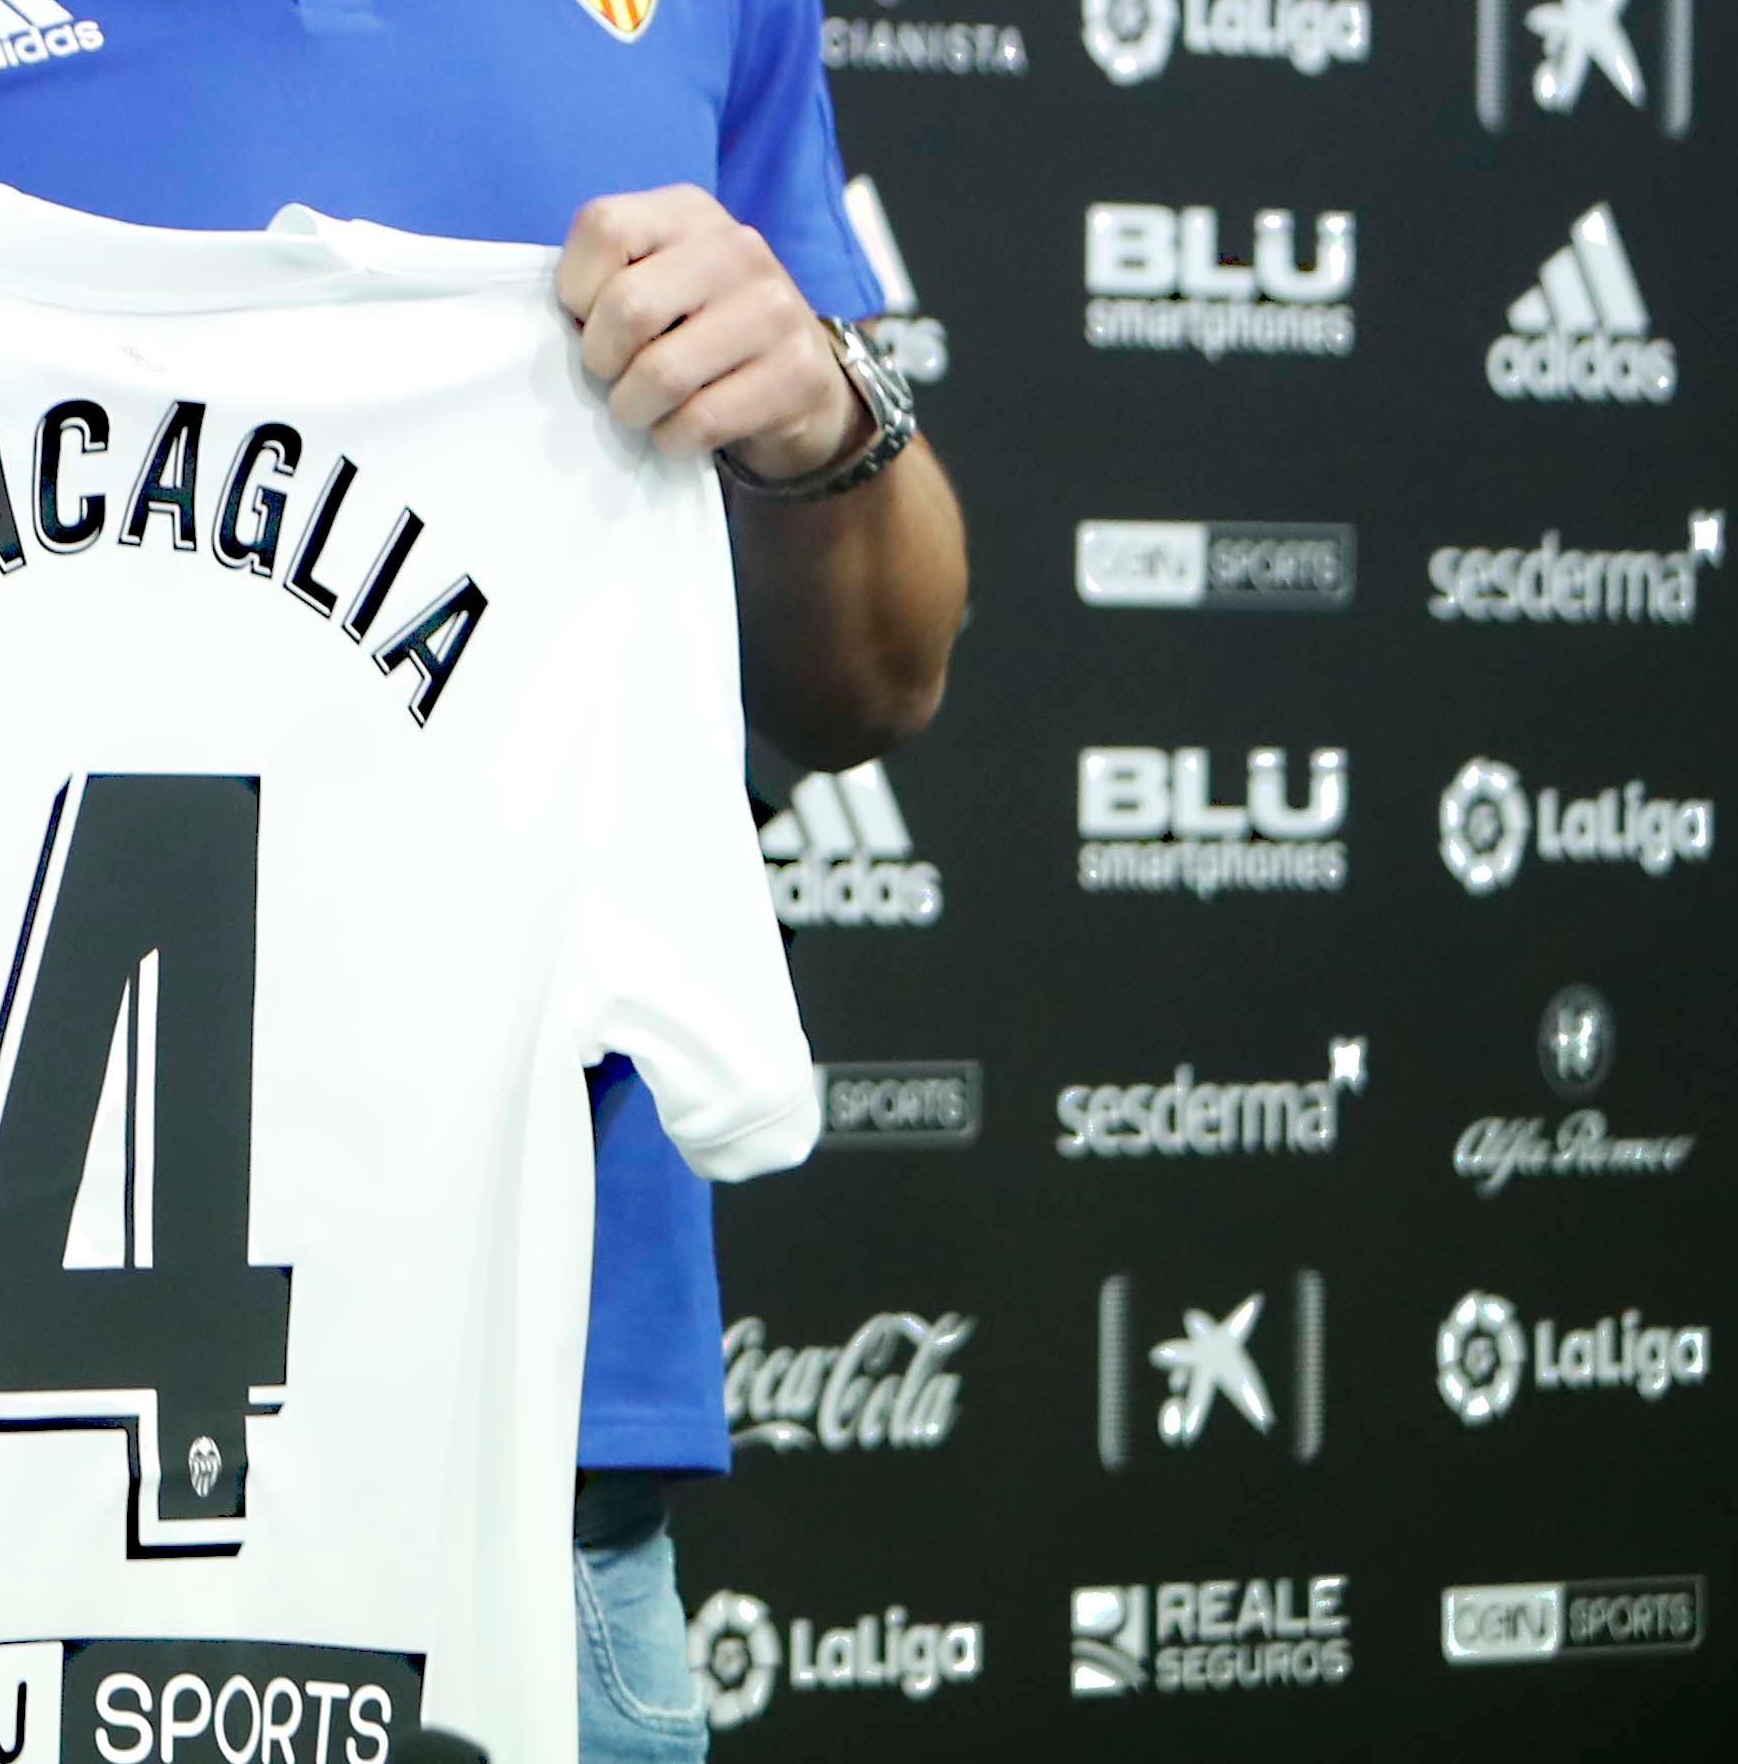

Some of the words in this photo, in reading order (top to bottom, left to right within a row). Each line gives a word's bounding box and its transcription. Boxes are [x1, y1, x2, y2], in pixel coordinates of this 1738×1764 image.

[1485, 329, 1678, 403] adidas
[1427, 531, 1696, 624] sesderma
[1535, 779, 1715, 876] LaLiga
[775, 854, 942, 927] didas
[829, 1076, 967, 1131] SPORTS
[1056, 1064, 1337, 1158] sesderma
[1534, 1308, 1711, 1400] LaLiga
[1156, 1574, 1350, 1641] REALE
[1569, 1592, 1694, 1643] SPORTS
[789, 1605, 983, 1698] LaLiga
[1154, 1639, 1353, 1692] SEGUROS
[94, 1672, 393, 1764] SPORTS
